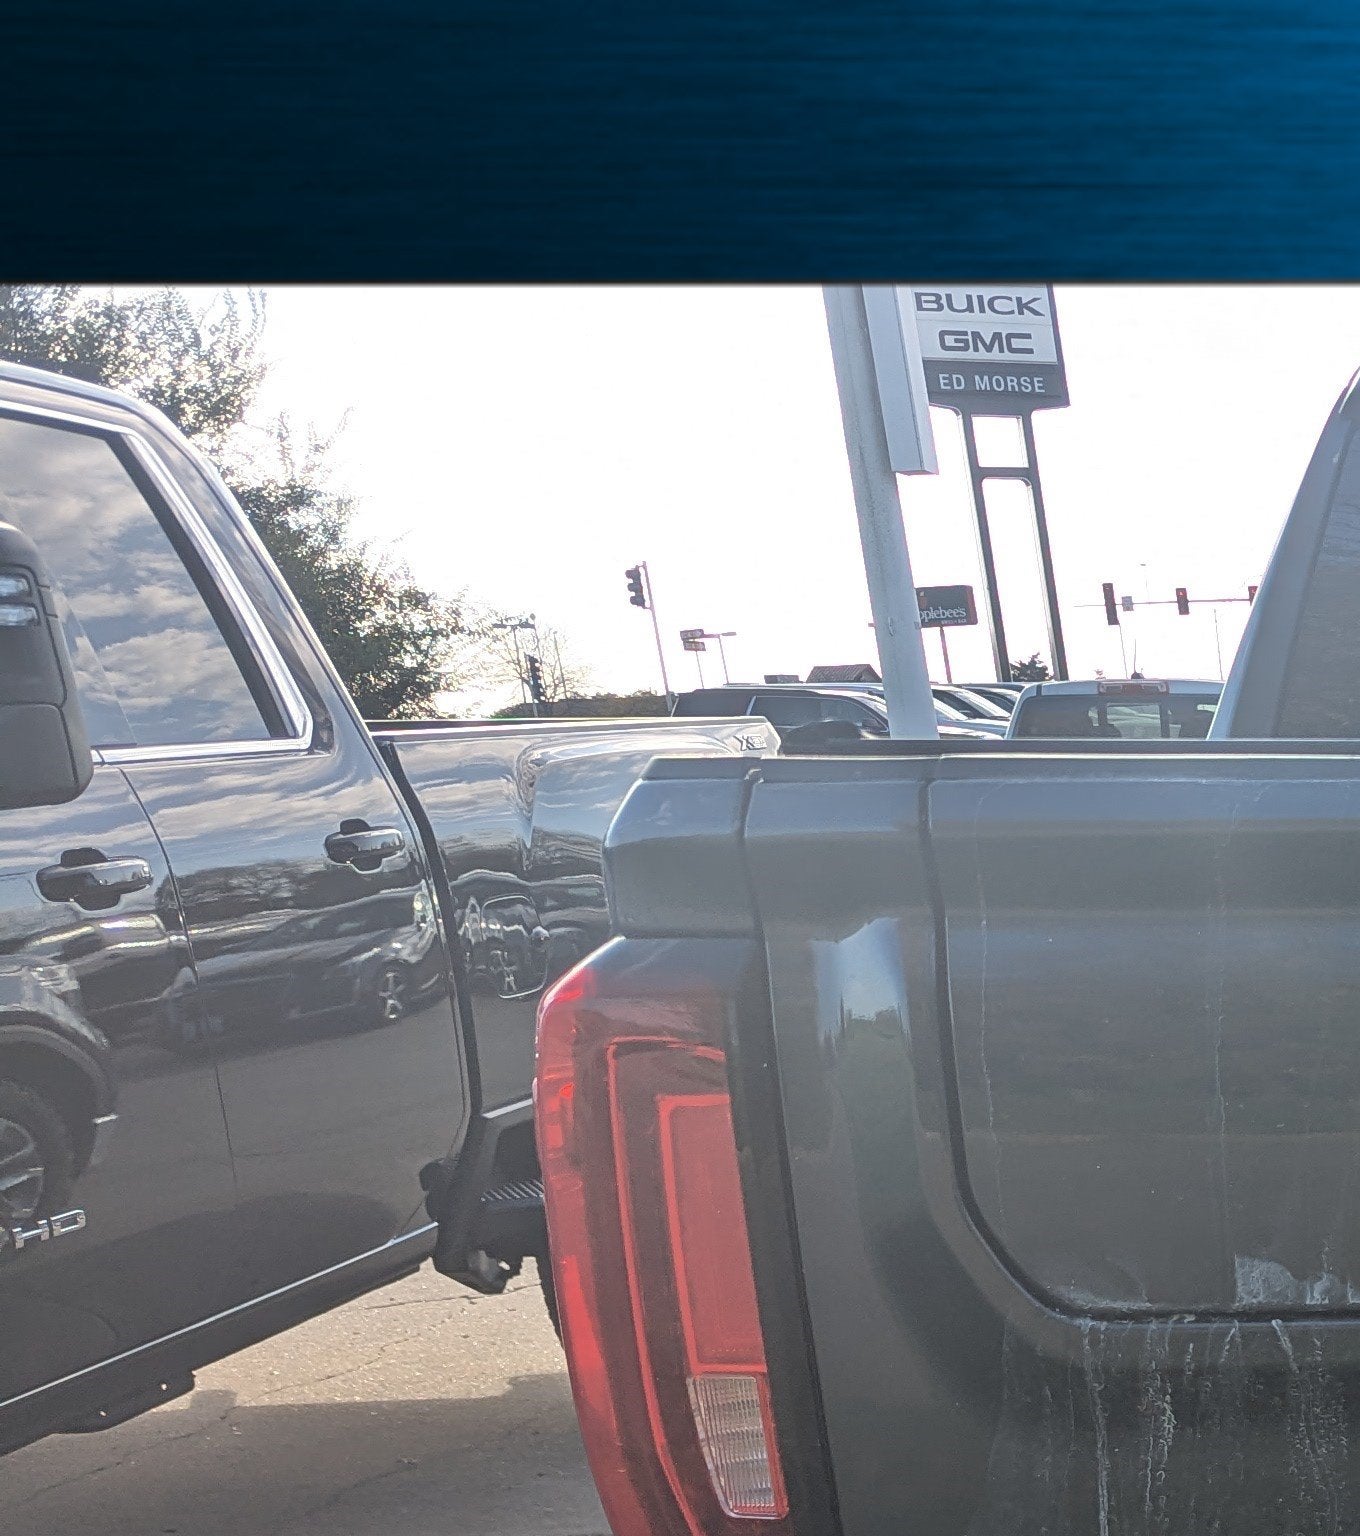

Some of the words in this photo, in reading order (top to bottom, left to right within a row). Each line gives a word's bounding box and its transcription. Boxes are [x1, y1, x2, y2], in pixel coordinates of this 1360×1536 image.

[914, 292, 1045, 317] BUICK
[938, 329, 1035, 355] GMC
[938, 373, 965, 390] ED
[974, 374, 1046, 393] MORSE
[919, 606, 967, 623] plebee's
